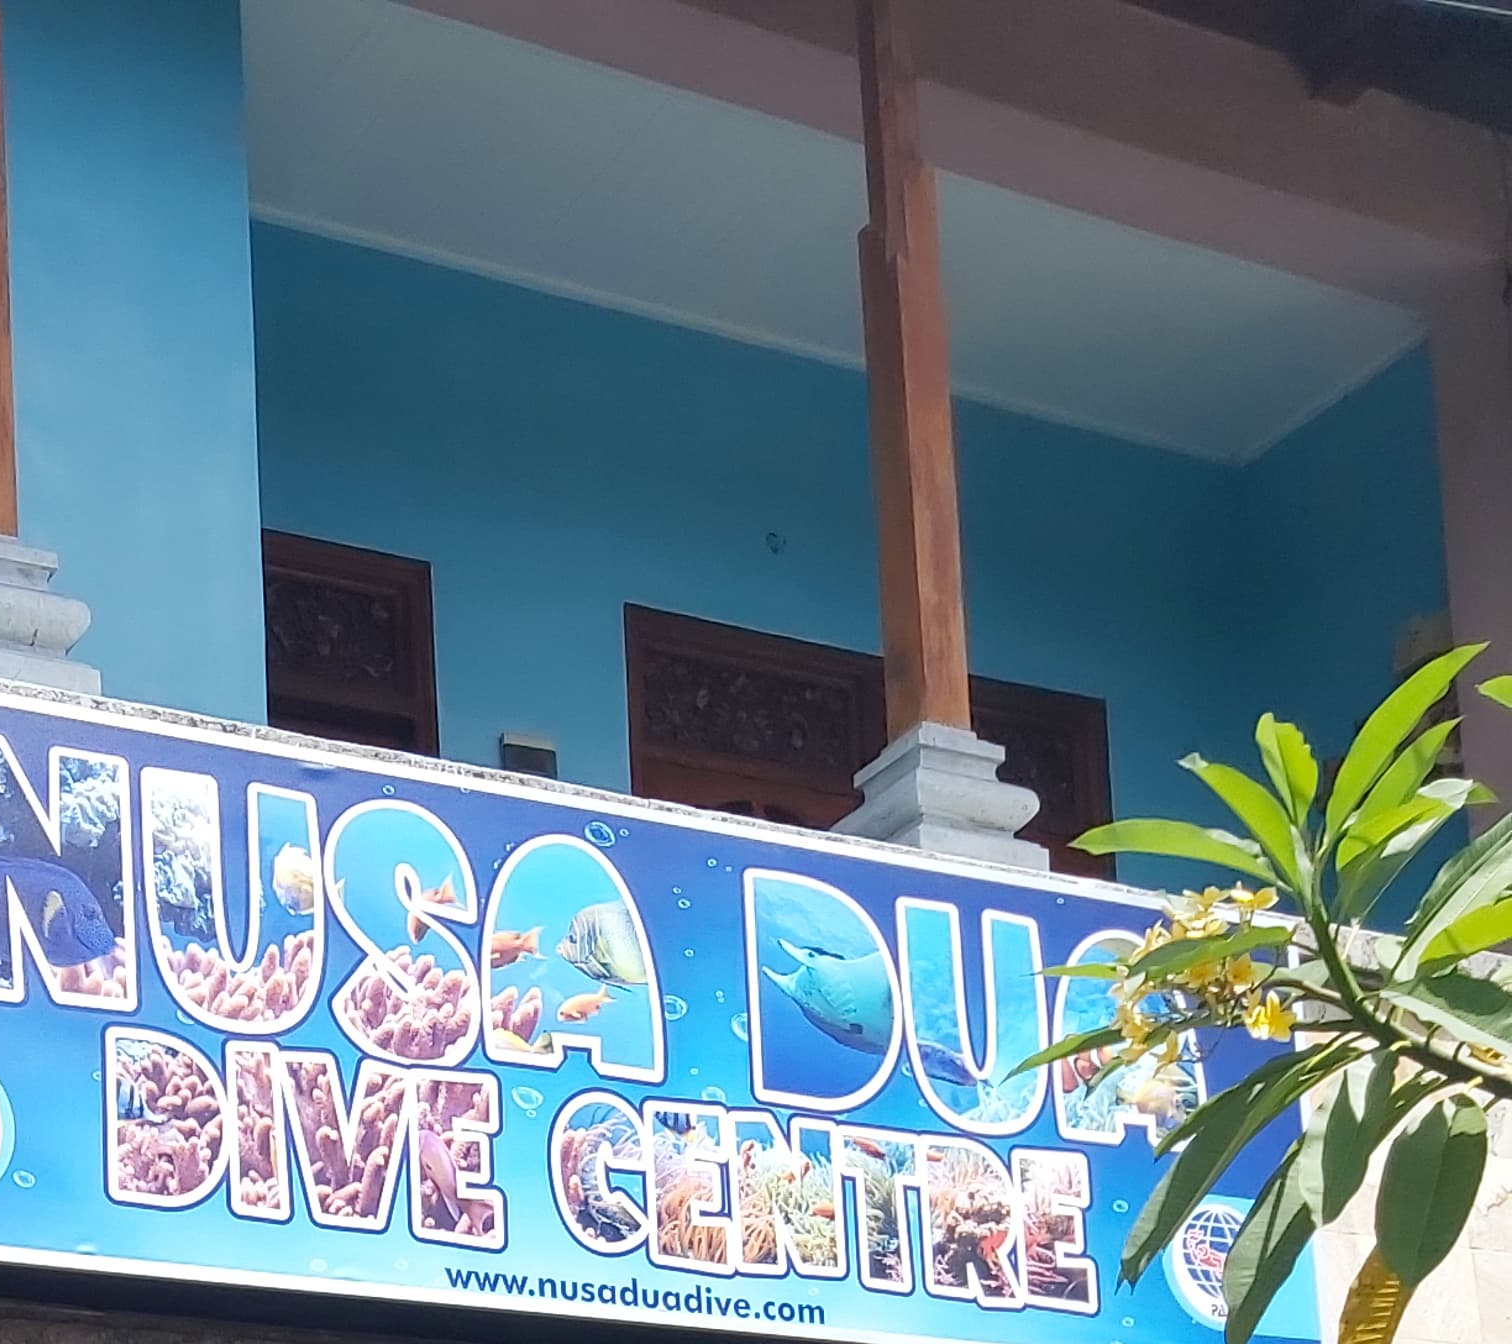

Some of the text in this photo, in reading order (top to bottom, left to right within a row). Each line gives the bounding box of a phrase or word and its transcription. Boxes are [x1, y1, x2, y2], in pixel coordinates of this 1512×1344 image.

[102, 1023, 1100, 1316] DIVE CENTRE
[444, 1266, 826, 1326] www.nusaduadive.com
